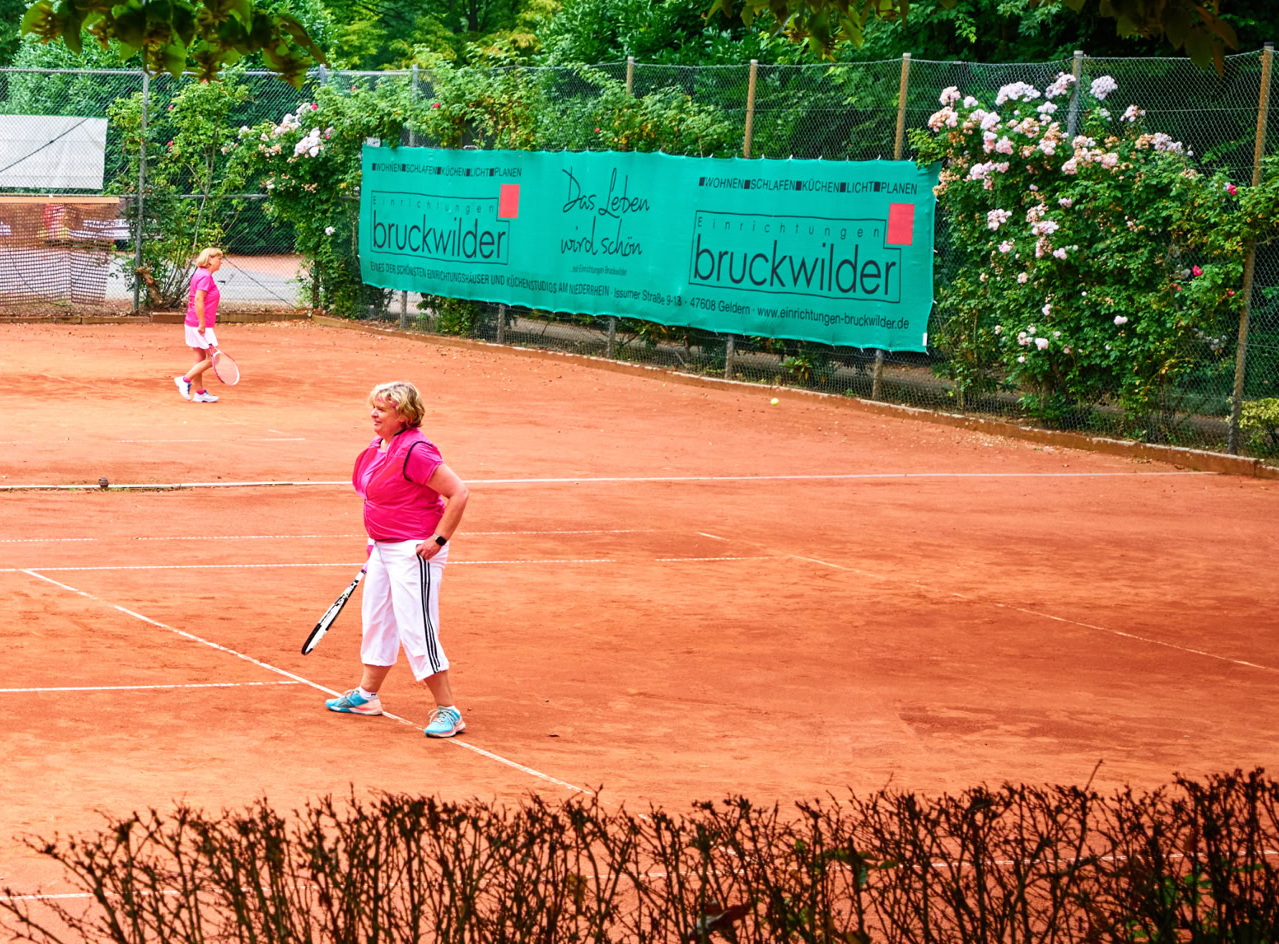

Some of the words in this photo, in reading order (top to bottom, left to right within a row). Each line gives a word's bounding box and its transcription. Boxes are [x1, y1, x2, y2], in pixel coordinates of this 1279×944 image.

[376, 163, 402, 172] WOHNEN
[406, 164, 437, 175] SCHLAFEN
[441, 166, 466, 176] KÜCHEN
[470, 168, 489, 177] LICHT
[494, 168, 522, 177] PLANEN
[705, 177, 743, 189] WOHNEN
[751, 178, 796, 192] SCHLAFEN
[802, 178, 840, 193] KÜCHEN
[846, 181, 874, 193] LICHT
[880, 181, 917, 195] PLANEN
[373, 196, 494, 215] Einrichtungen
[562, 166, 596, 213] Das
[598, 167, 650, 219] Leben
[373, 210, 506, 259] bruckwilder
[561, 216, 598, 256] wird
[601, 218, 643, 257] schön
[697, 216, 879, 240] Einrichtungen
[694, 233, 896, 295] bruckwilder
[371, 261, 385, 273] EINES
[386, 263, 396, 274] DER
[396, 264, 426, 278] SCHÖNSTEN
[427, 269, 490, 285] EINRICHTUNGSHÄUSER
[491, 274, 505, 286] UND
[506, 275, 557, 294] KÜCHENSTUDIOS
[558, 282, 568, 293] AM
[569, 283, 610, 297] NIEDERRHEIN
[614, 287, 641, 300] Issumer
[642, 289, 665, 306] Straße
[689, 296, 716, 311] 47608
[718, 299, 750, 316] Geldern
[757, 306, 909, 330] www.einrichtungen-bruckwilder.de
